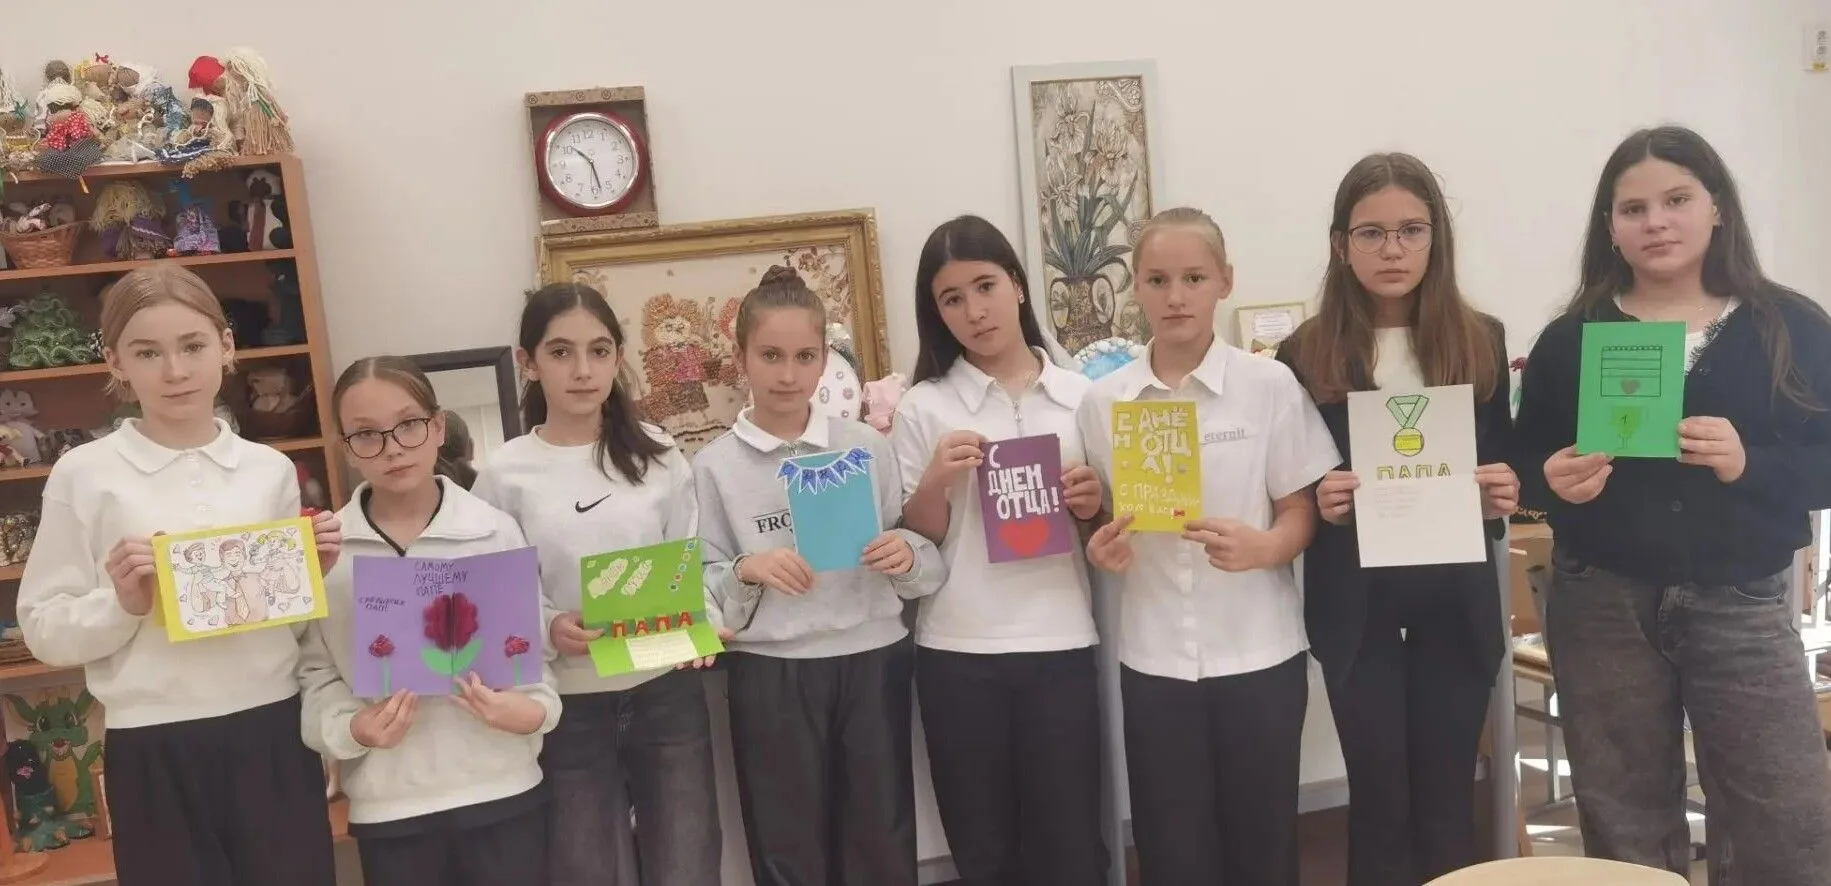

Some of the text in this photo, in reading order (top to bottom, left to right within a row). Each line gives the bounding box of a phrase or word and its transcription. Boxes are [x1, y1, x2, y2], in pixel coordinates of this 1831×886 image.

[571, 134, 581, 144] 11
[582, 130, 594, 139] 12
[563, 146, 573, 155] 10
[611, 141, 619, 151] 2
[617, 155, 624, 164] 3
[566, 173, 572, 183] 8
[605, 180, 613, 190] 5
[988, 443, 1001, 468] С
[1376, 463, 1451, 480] ПАПА
[988, 463, 1044, 496] ДНЕМ
[996, 486, 1060, 520] ОТЦА!
[413, 570, 468, 585] ЛУЧШЕМУ
[612, 610, 693, 639] ПАПА
